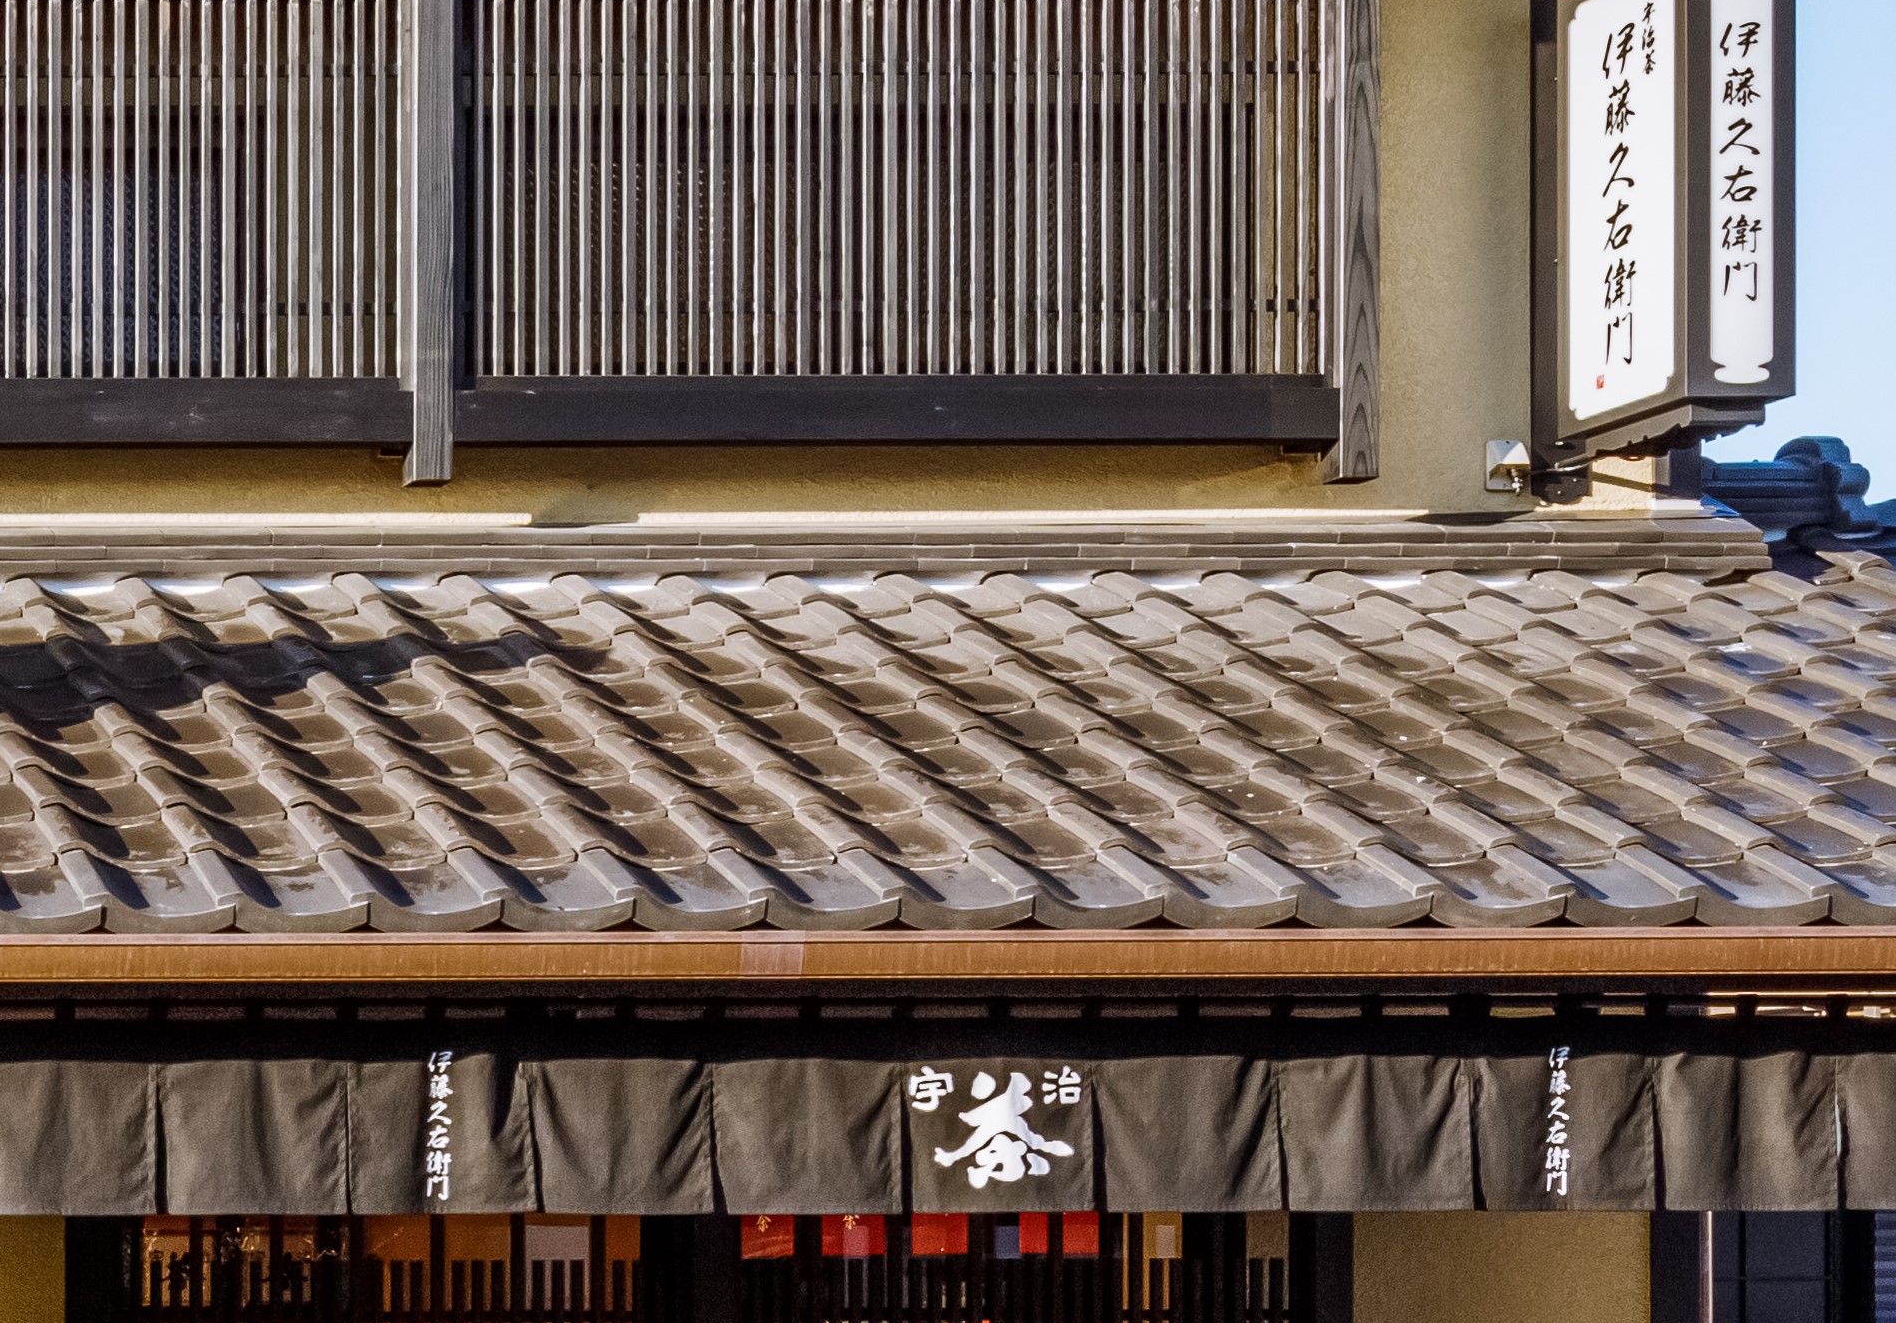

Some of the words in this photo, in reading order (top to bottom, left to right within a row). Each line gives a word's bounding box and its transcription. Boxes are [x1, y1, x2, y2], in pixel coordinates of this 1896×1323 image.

[1640, 1, 1657, 76] 宇治茶
[1601, 21, 1637, 366] 伊藤久右衛門
[1718, 20, 1763, 303] 伊藤久右衛門
[425, 1050, 455, 1202] 伊藤久右衛門
[932, 1070, 1076, 1190] 茶
[1544, 1046, 1572, 1197] 伊藤久右衛門
